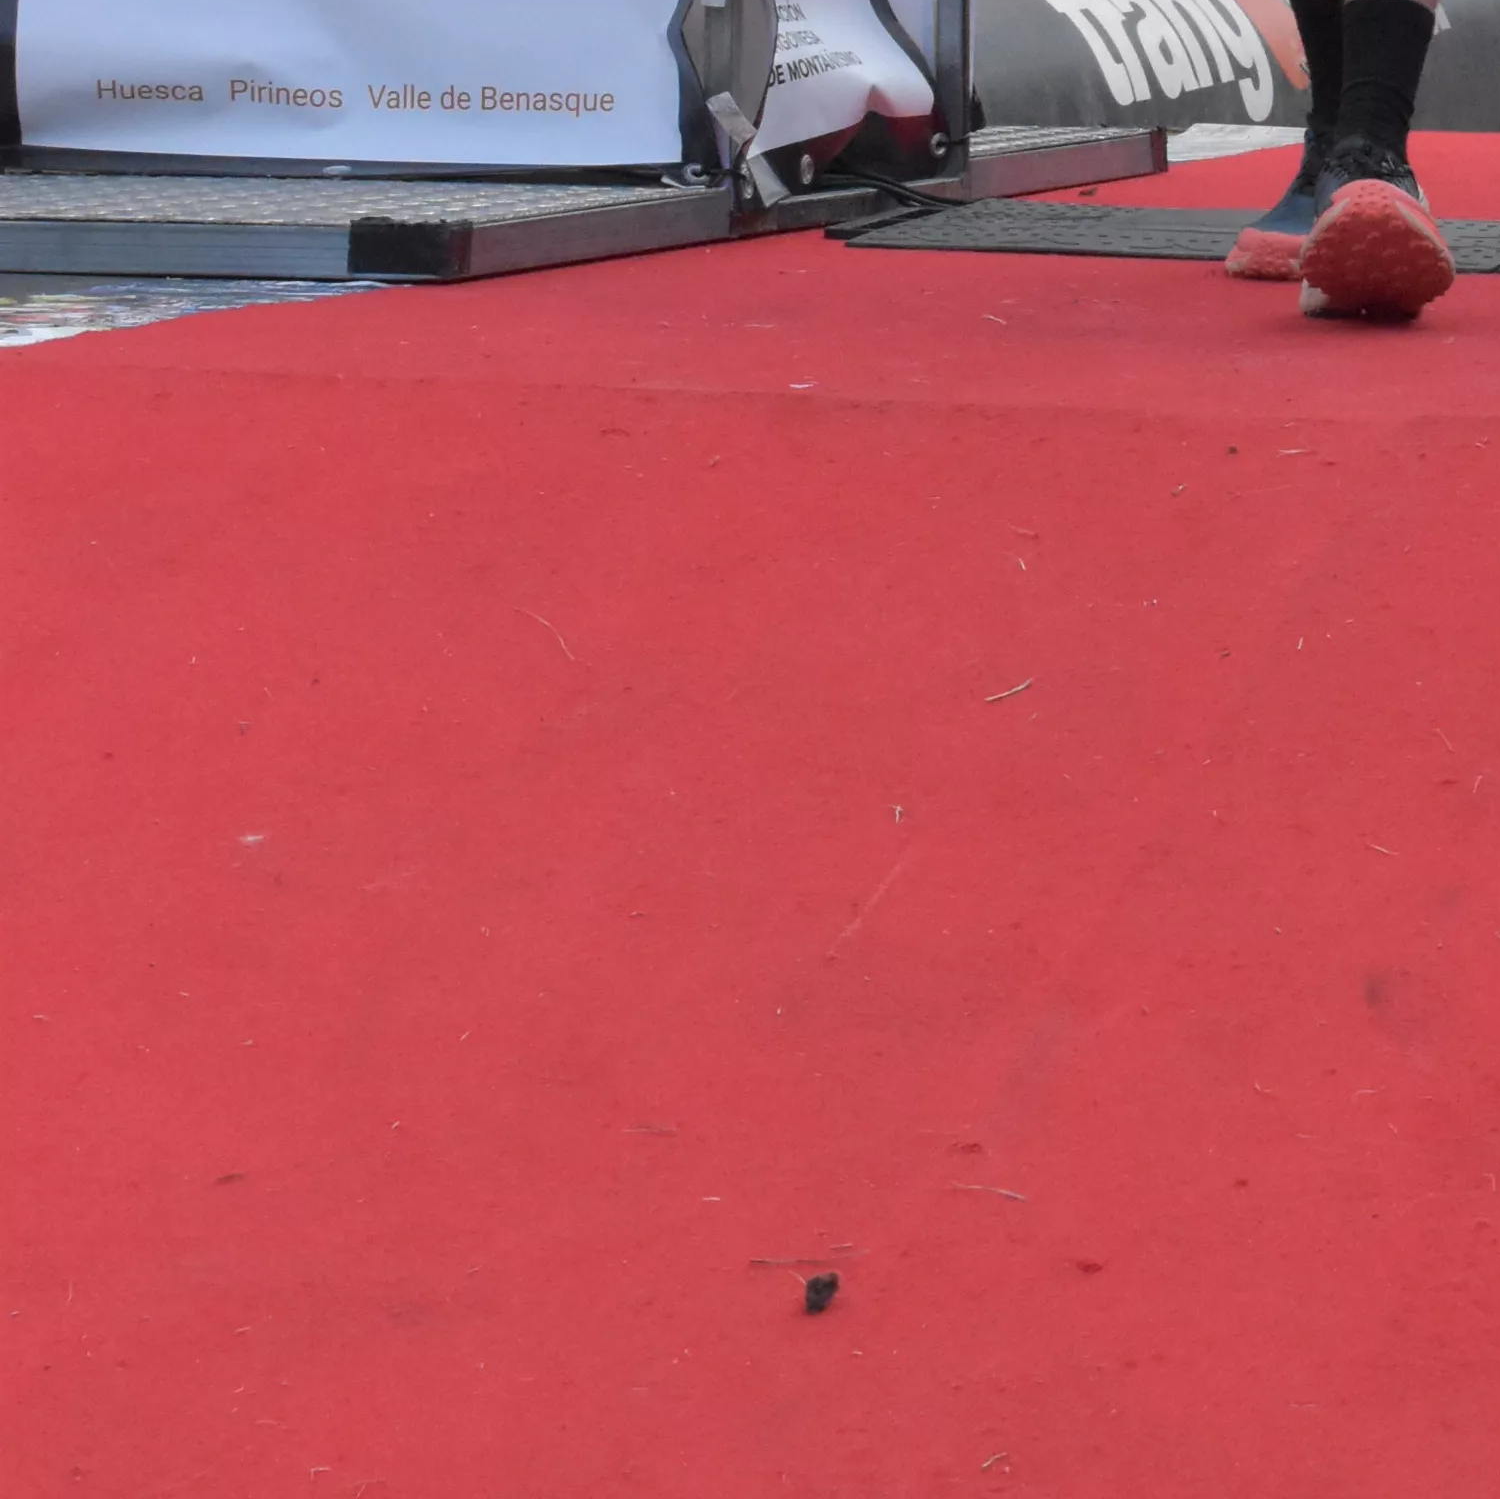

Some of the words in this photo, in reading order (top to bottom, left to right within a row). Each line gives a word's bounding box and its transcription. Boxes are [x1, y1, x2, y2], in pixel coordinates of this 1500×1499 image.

[96, 78, 205, 102] Huesca
[229, 80, 344, 109] Pirineos
[367, 83, 434, 111] Valle
[439, 84, 472, 112] de
[479, 85, 616, 116] Benasque
